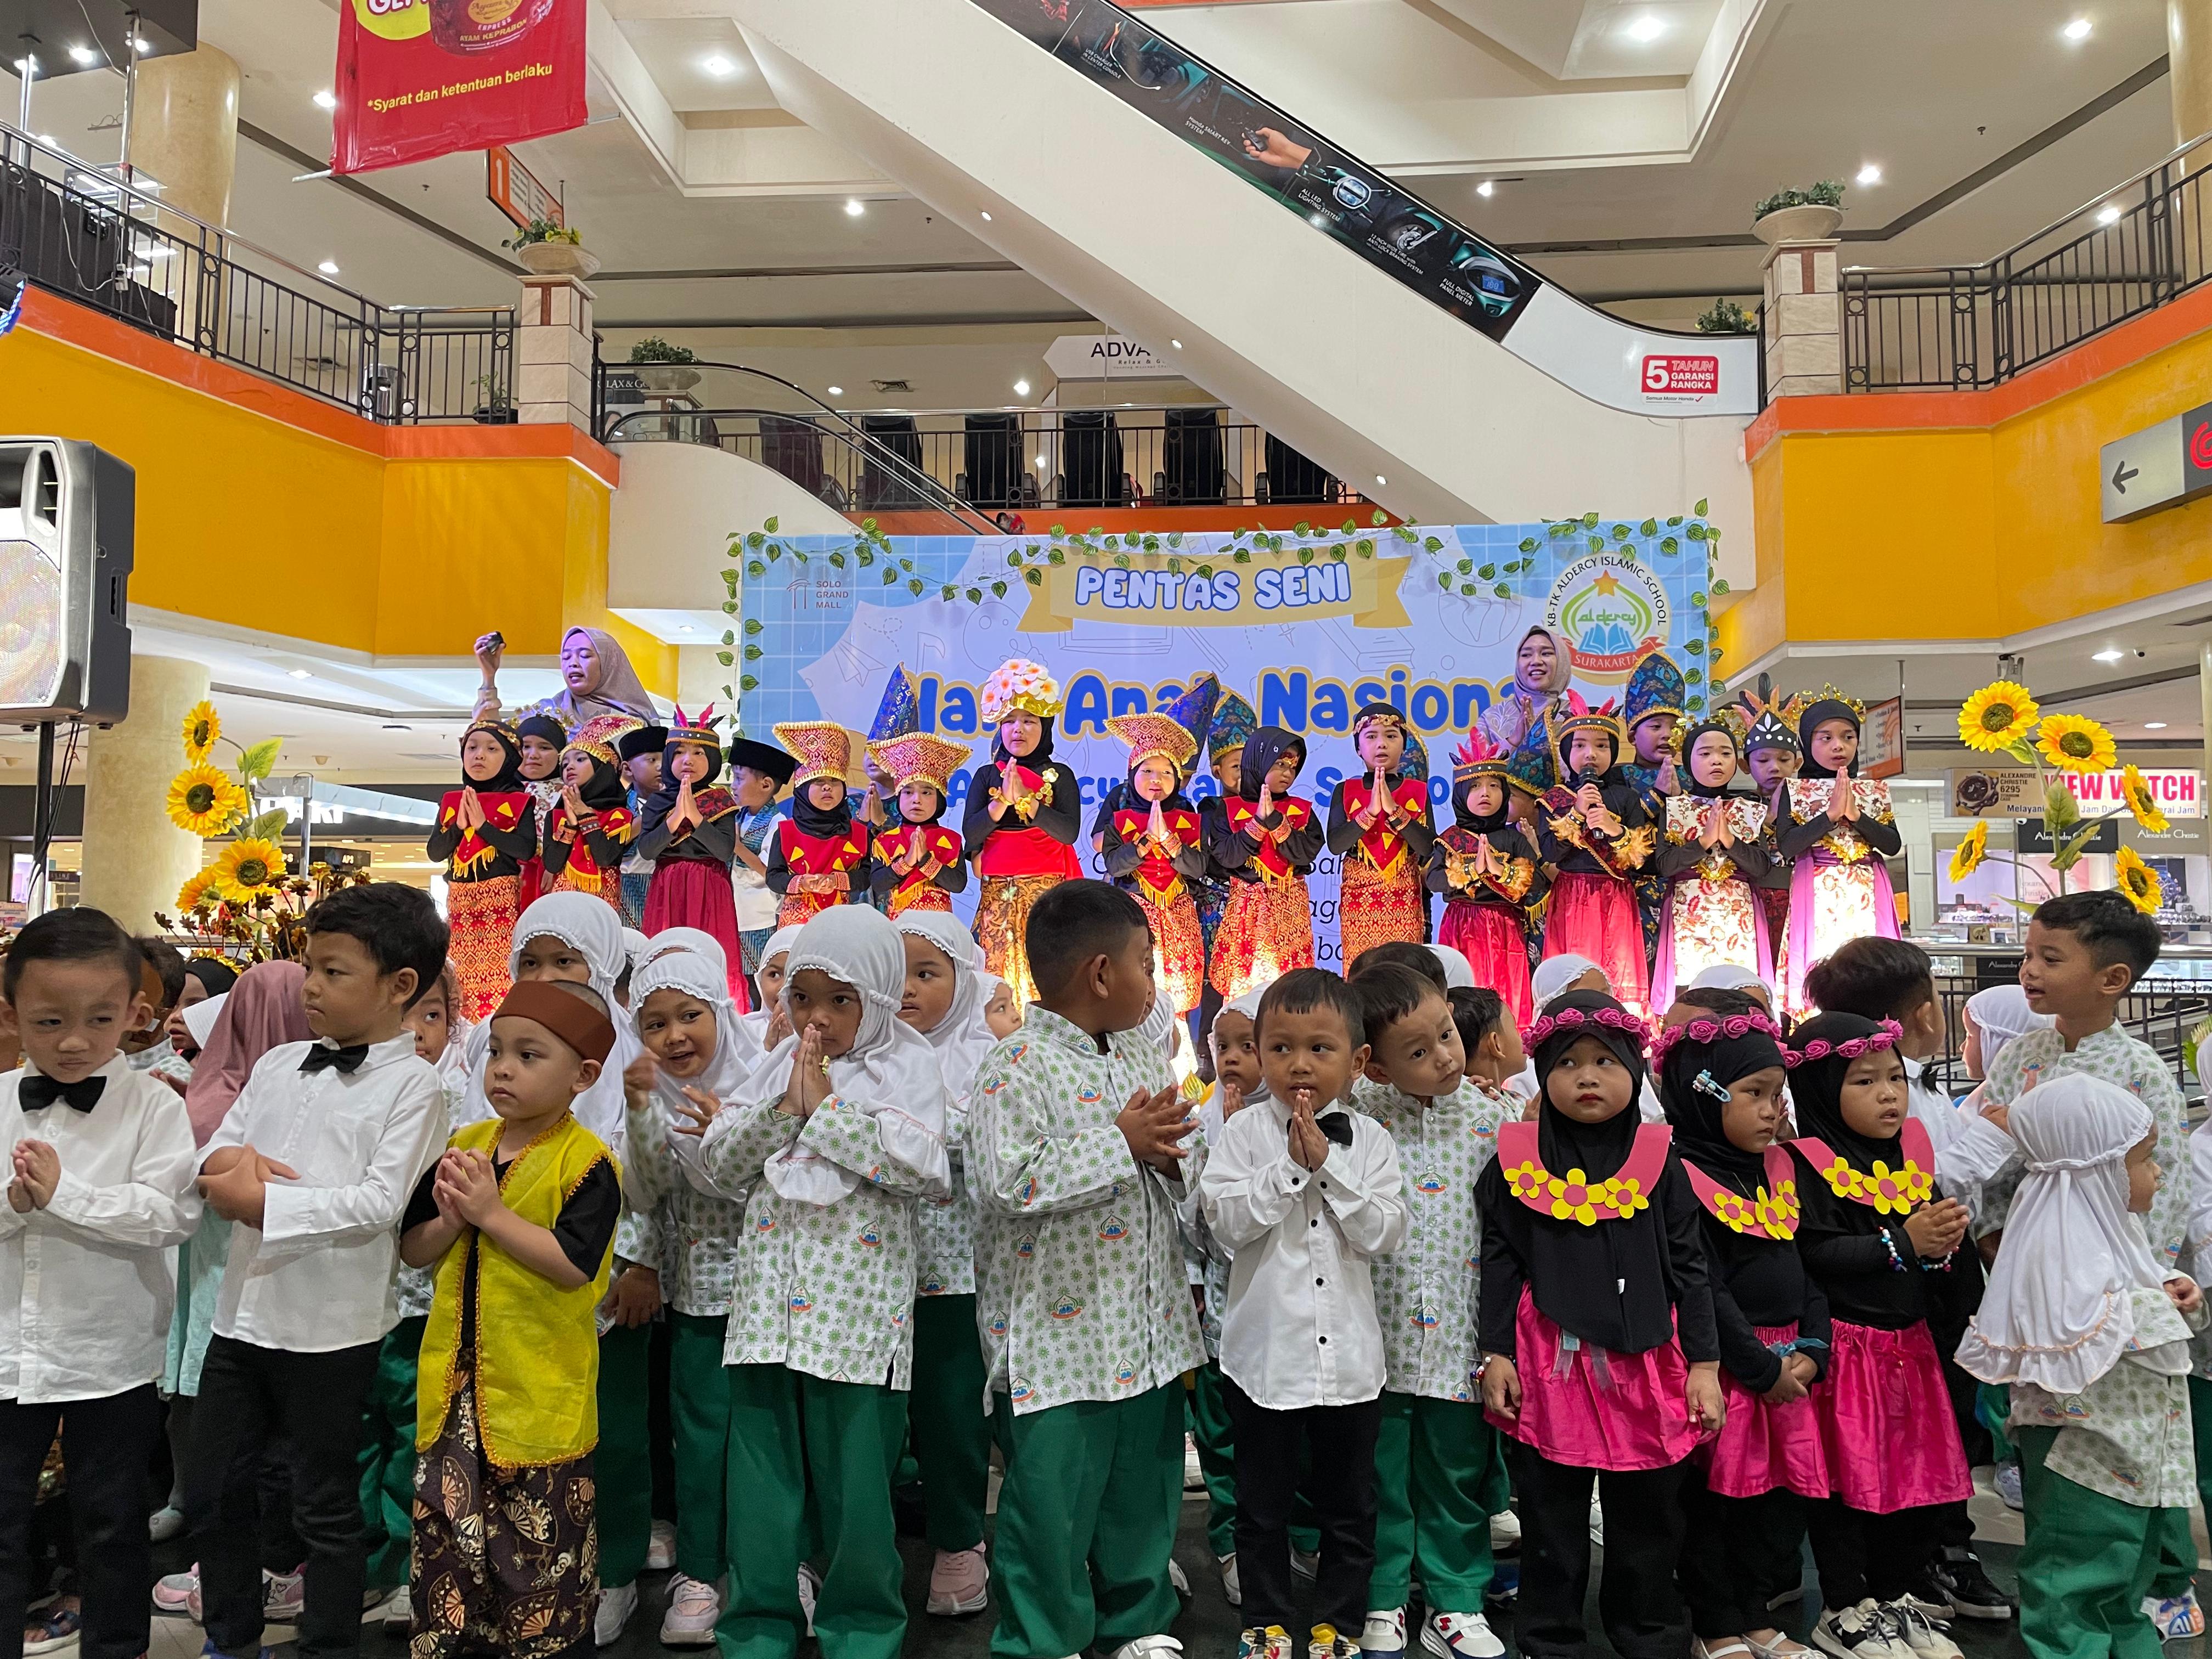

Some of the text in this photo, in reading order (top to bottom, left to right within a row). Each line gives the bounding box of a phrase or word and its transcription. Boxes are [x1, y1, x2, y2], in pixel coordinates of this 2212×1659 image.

[415, 89, 438, 103] dan
[442, 75, 502, 98] ketentuan
[505, 63, 552, 83] berlaku
[1185, 120, 1204, 135] SYSTEM
[1204, 126, 1222, 139] SMART
[1220, 136, 1231, 145] KEY
[1301, 188, 1322, 203] ALL LED
[1298, 193, 1341, 222] LIGHTING SYSTEM
[1406, 262, 1424, 275] SYSTEM
[1439, 283, 1473, 307] PANEL METER
[1442, 278, 1475, 302] FULL DIGITAL
[1671, 360, 1714, 371] TAHUN
[1646, 360, 1669, 390] 5
[1671, 373, 1714, 381] GARANSI
[1671, 381, 1712, 389] RANGKA
[816, 580, 842, 589] SOLO
[1075, 562, 1351, 612] PENTAS SENI
[1547, 556, 1667, 627] KB-TK ALDERCY ISLAMIC SCHOOL
[2081, 805, 2099, 813] Jam
[2177, 806, 2195, 814] Jam
